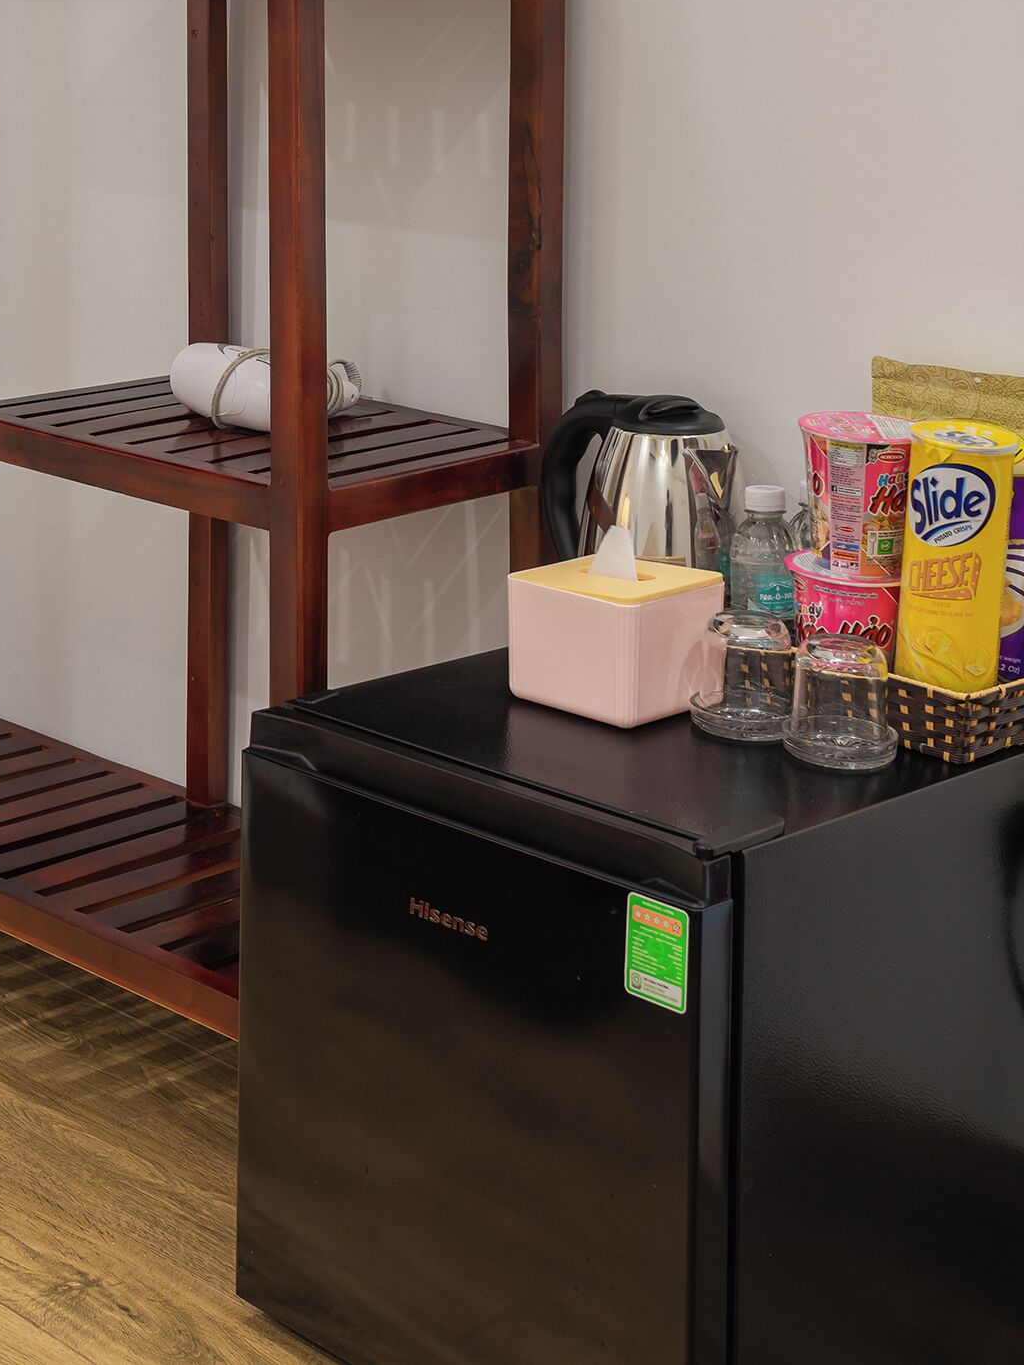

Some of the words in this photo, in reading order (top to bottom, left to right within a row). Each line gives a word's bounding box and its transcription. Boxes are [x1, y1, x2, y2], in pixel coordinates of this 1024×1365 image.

[911, 476, 986, 535] Slide
[933, 530, 953, 544] POTATO
[953, 523, 973, 535] CRISPS
[909, 552, 974, 592] CHEESE
[409, 896, 489, 942] Hisense
